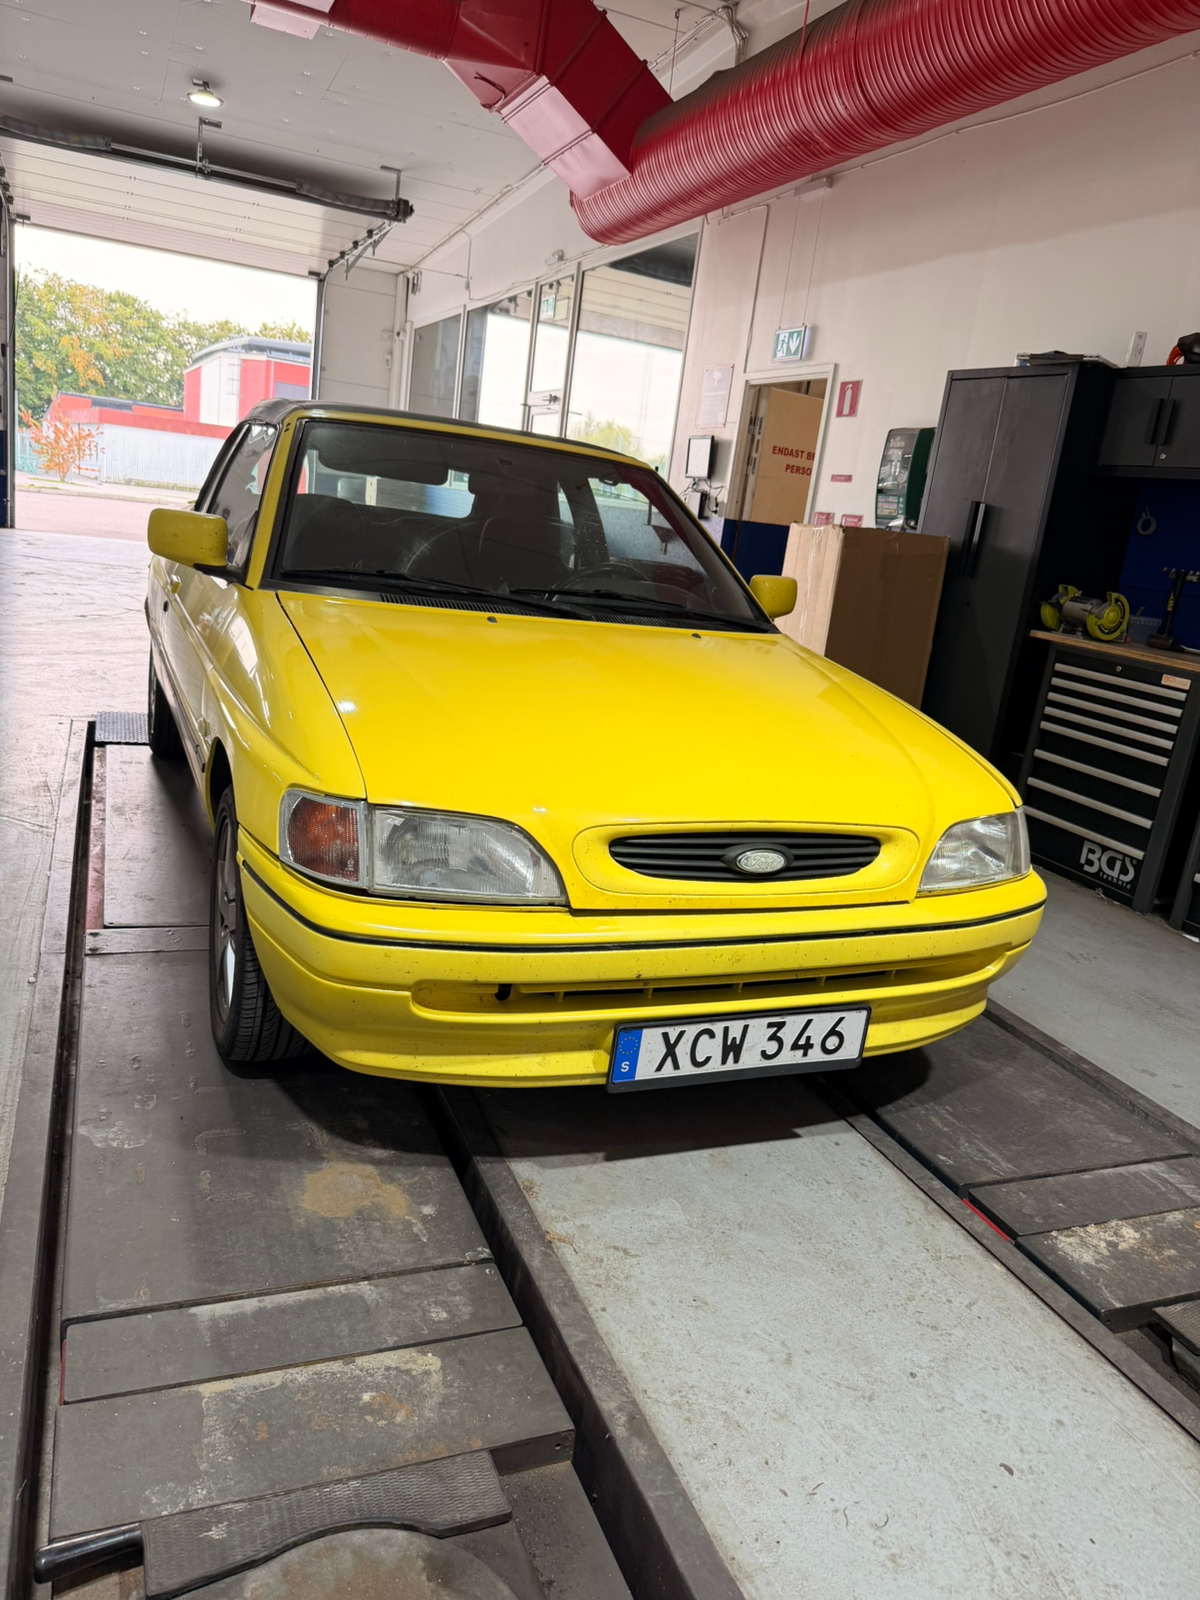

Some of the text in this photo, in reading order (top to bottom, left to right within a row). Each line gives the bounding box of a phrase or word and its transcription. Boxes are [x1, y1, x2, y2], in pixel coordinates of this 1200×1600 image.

[772, 445, 805, 459] ENDAST
[785, 463, 812, 476] PERSO
[750, 855, 776, 868] Ford
[1080, 840, 1135, 882] BGS
[1100, 871, 1131, 890] technic
[654, 1016, 846, 1072] XCW 346
[620, 1061, 630, 1073] S
